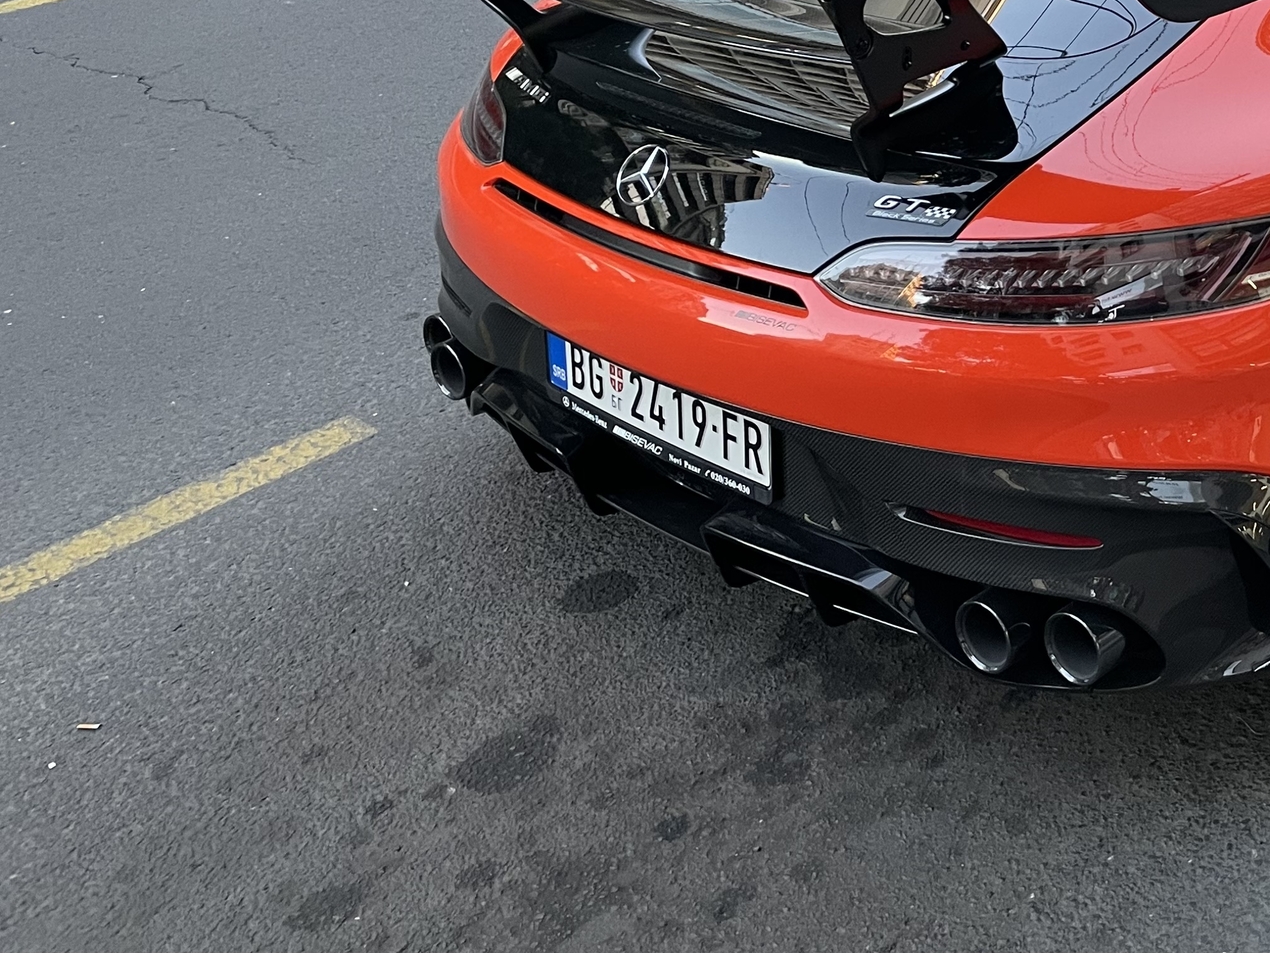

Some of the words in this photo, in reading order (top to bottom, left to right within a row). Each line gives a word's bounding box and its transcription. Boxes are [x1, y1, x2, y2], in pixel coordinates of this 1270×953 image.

[873, 194, 931, 213] GT
[872, 210, 899, 219] Black
[901, 214, 936, 224] Series
[552, 364, 566, 382] SRB
[571, 346, 604, 399] BG
[624, 430, 663, 456] BISEVAC
[668, 453, 682, 466] Novi
[683, 460, 702, 474] Pazar
